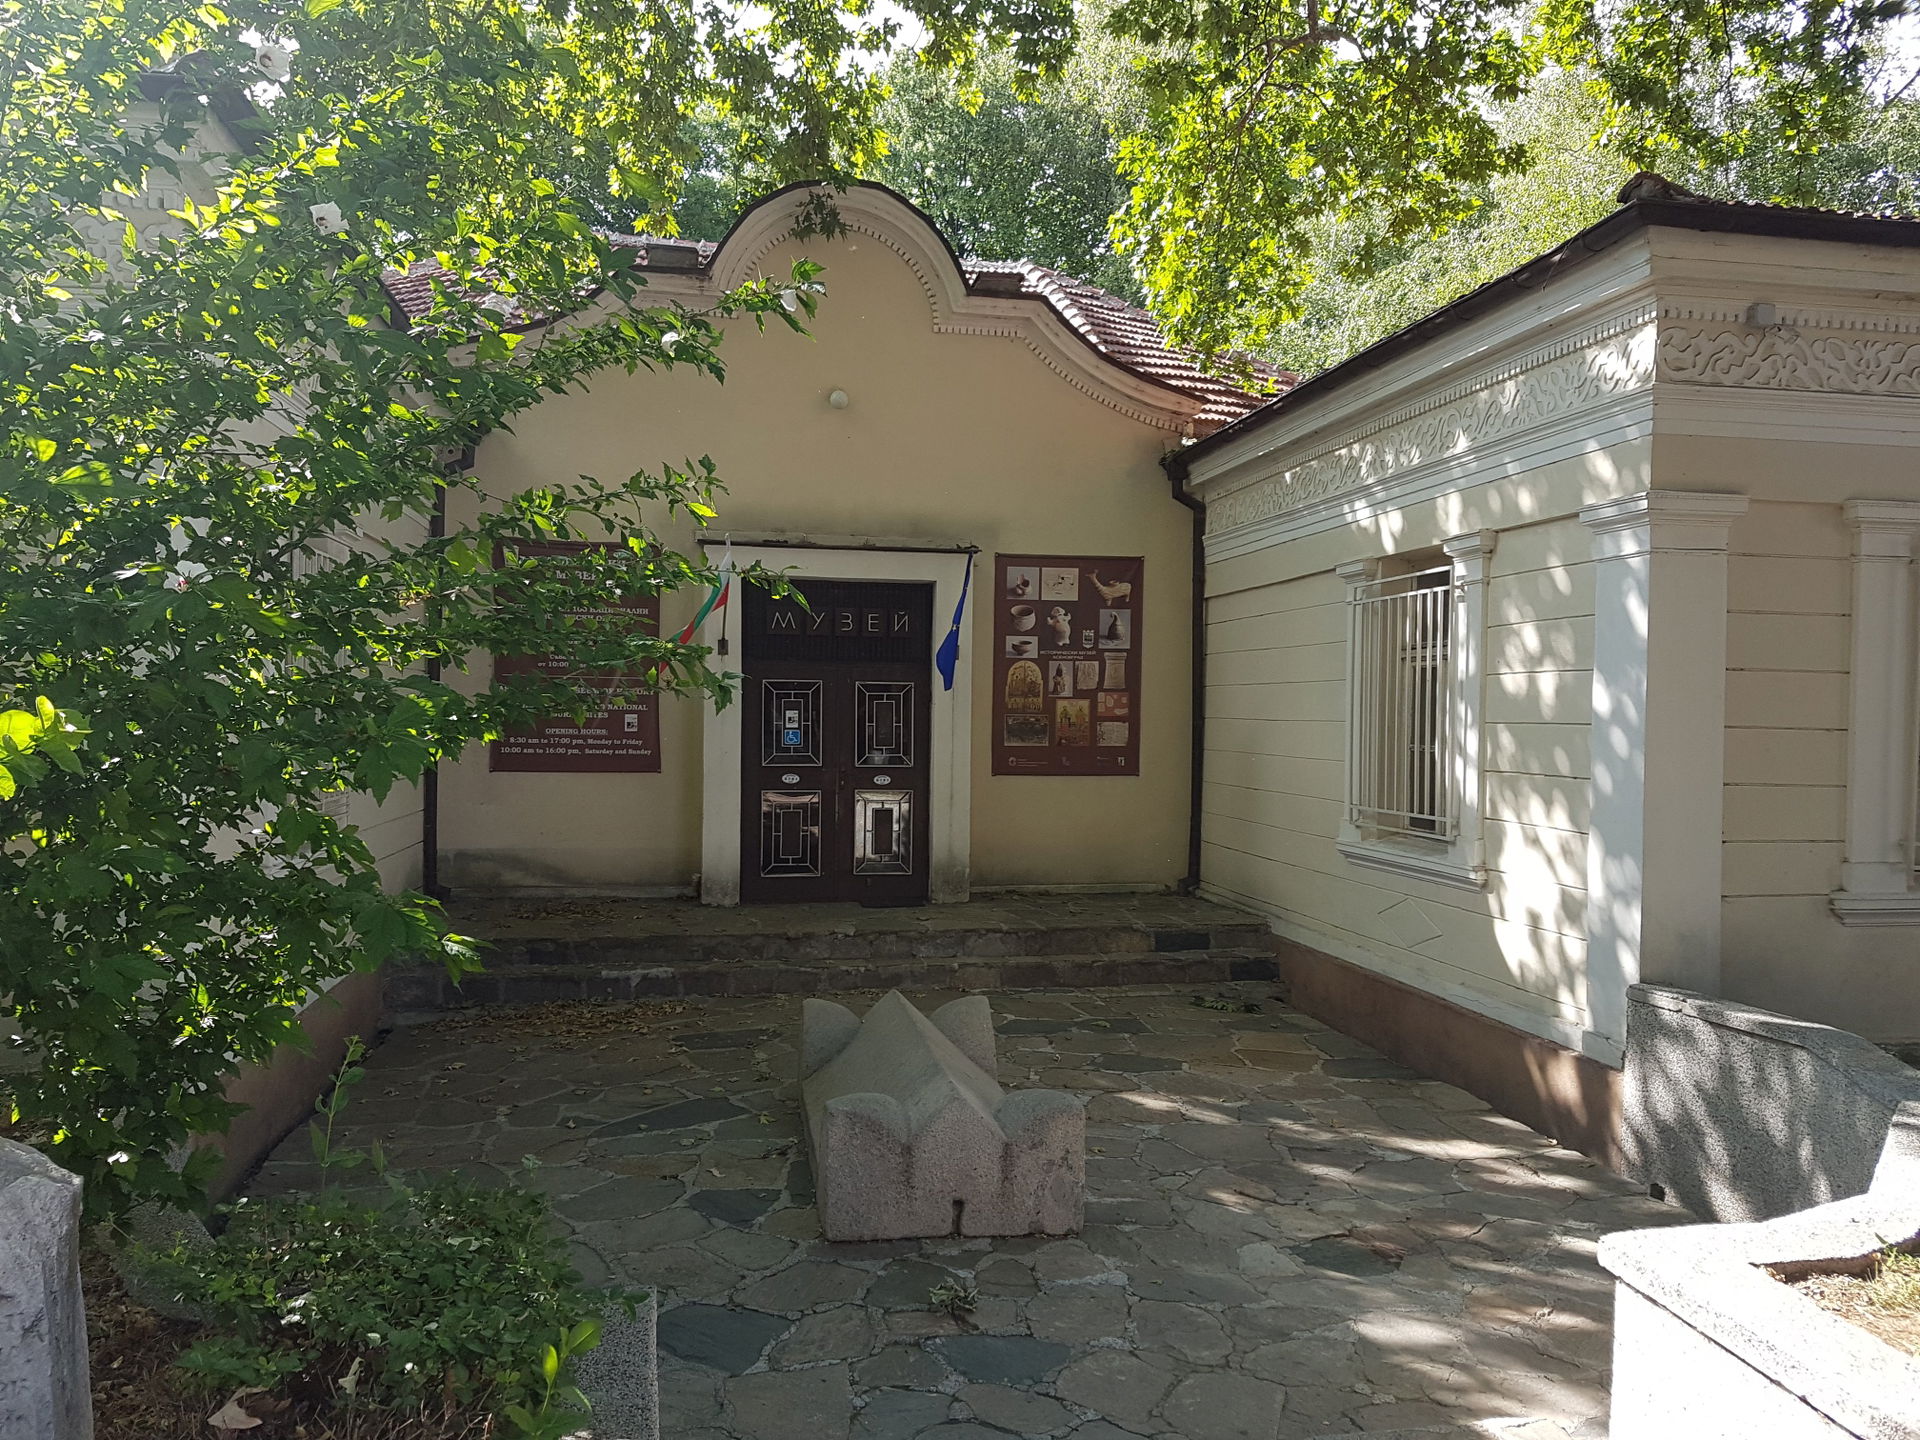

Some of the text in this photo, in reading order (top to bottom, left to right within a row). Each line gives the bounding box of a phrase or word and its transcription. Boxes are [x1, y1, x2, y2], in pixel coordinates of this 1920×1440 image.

[589, 607, 649, 615] НАЦИНАЛНИ
[771, 611, 909, 632] МУЗЕЙ
[509, 736, 526, 744] 8:30
